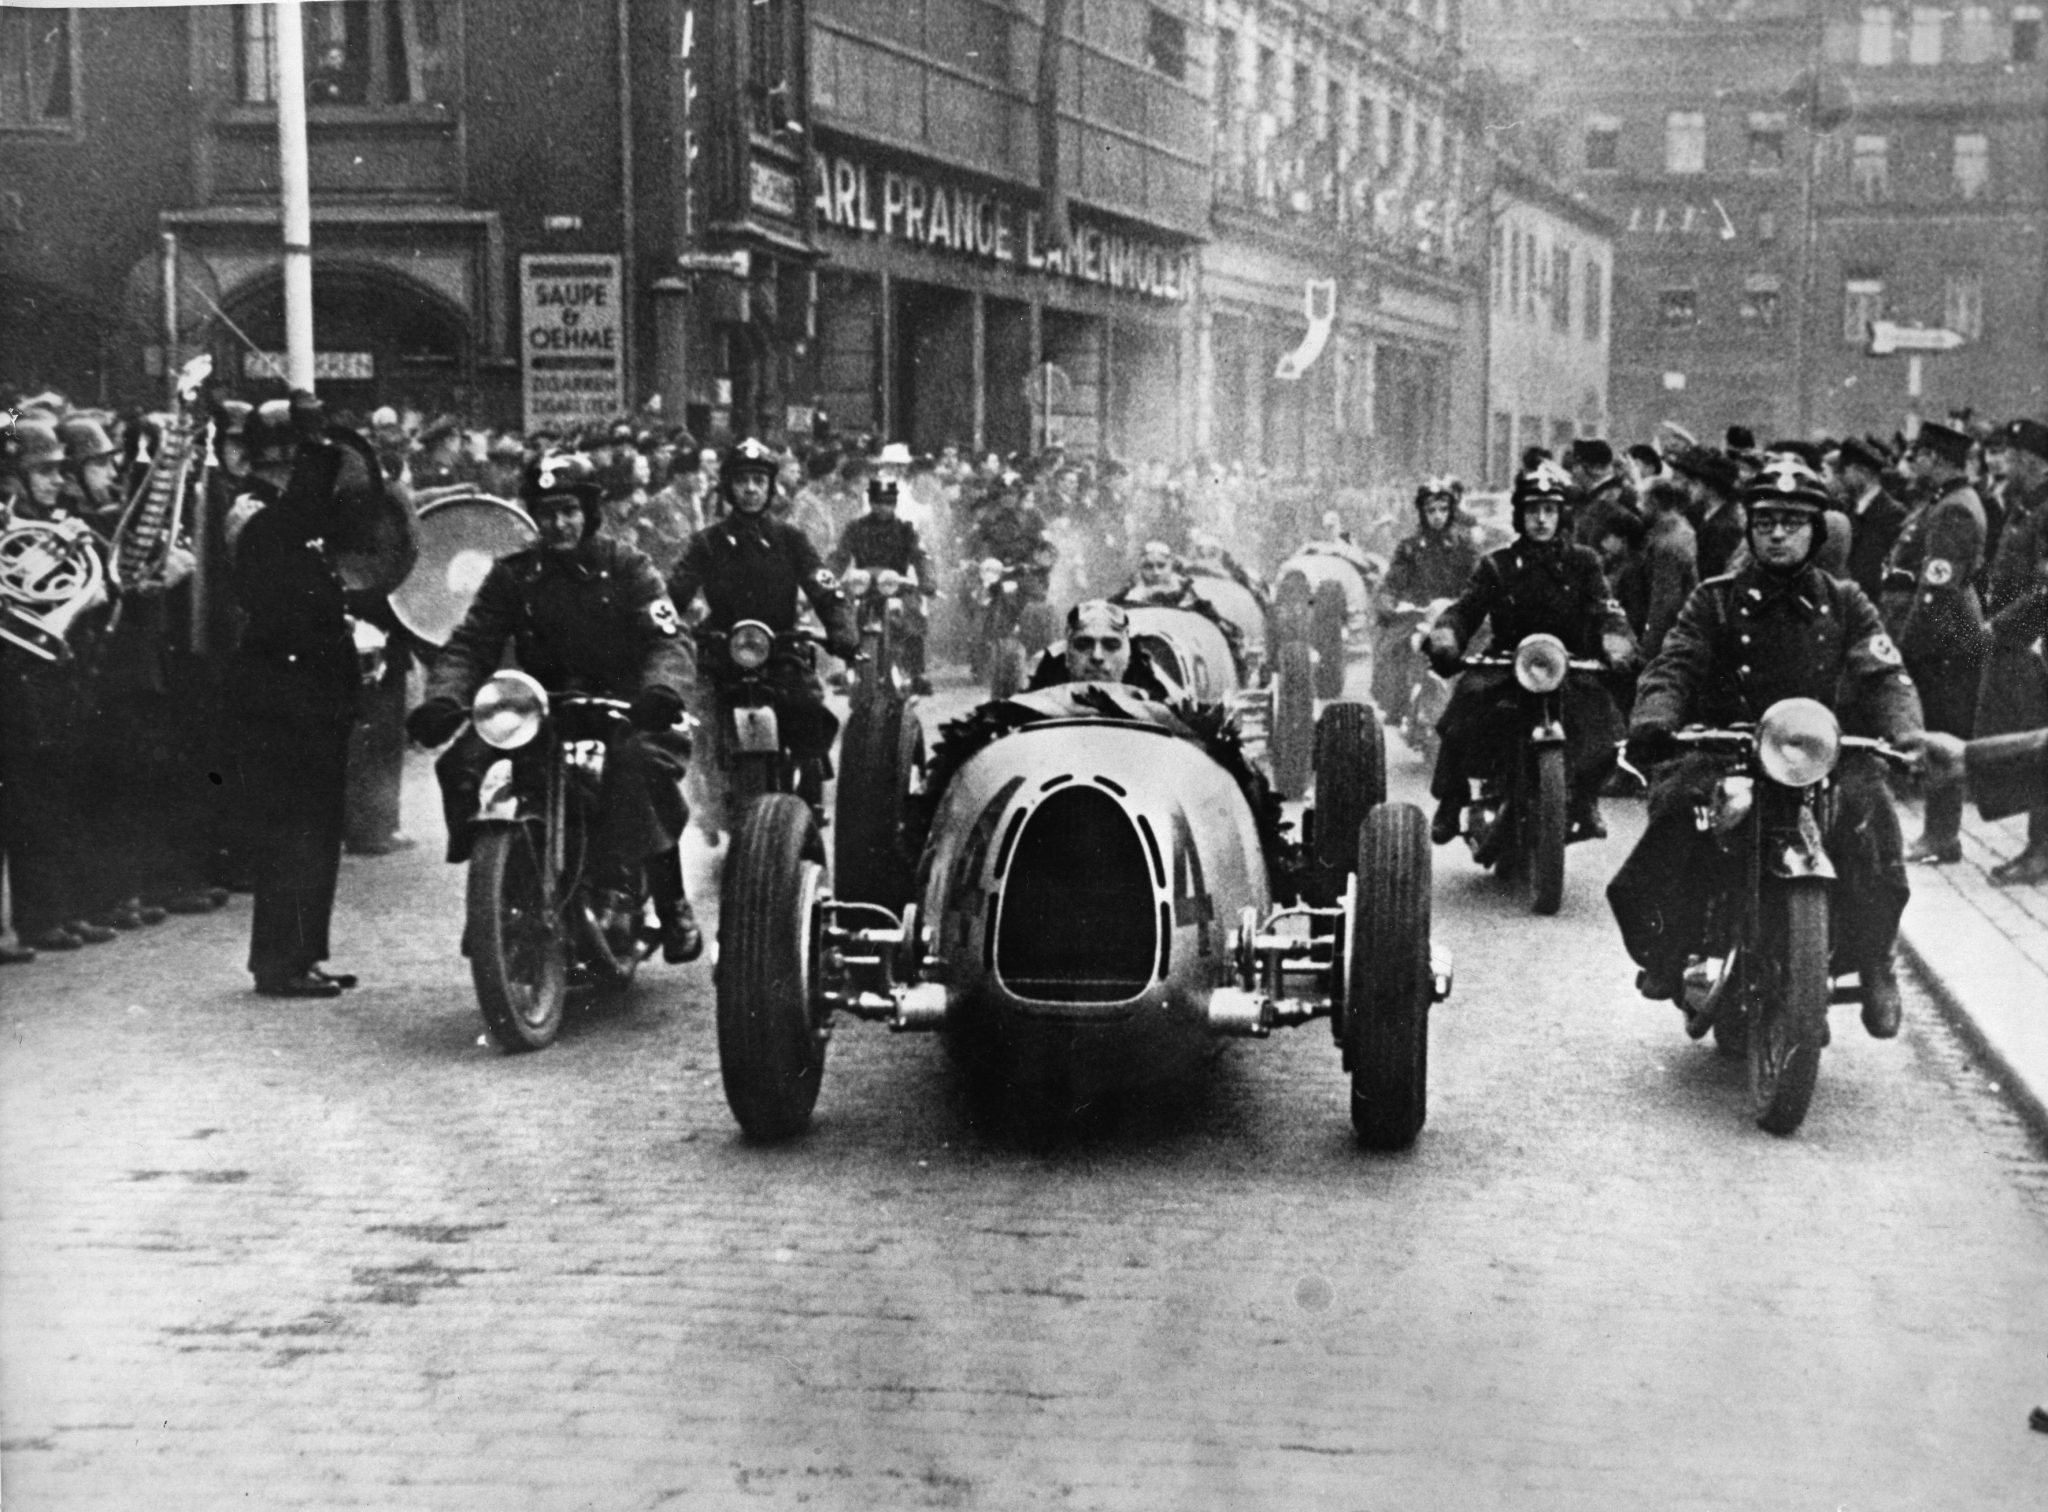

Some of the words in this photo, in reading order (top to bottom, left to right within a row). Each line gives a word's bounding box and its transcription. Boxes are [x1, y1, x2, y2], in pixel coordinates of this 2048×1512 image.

[884, 170, 1013, 260] PRANGE
[535, 283, 606, 306] SAUPE
[530, 327, 614, 349] OEHME
